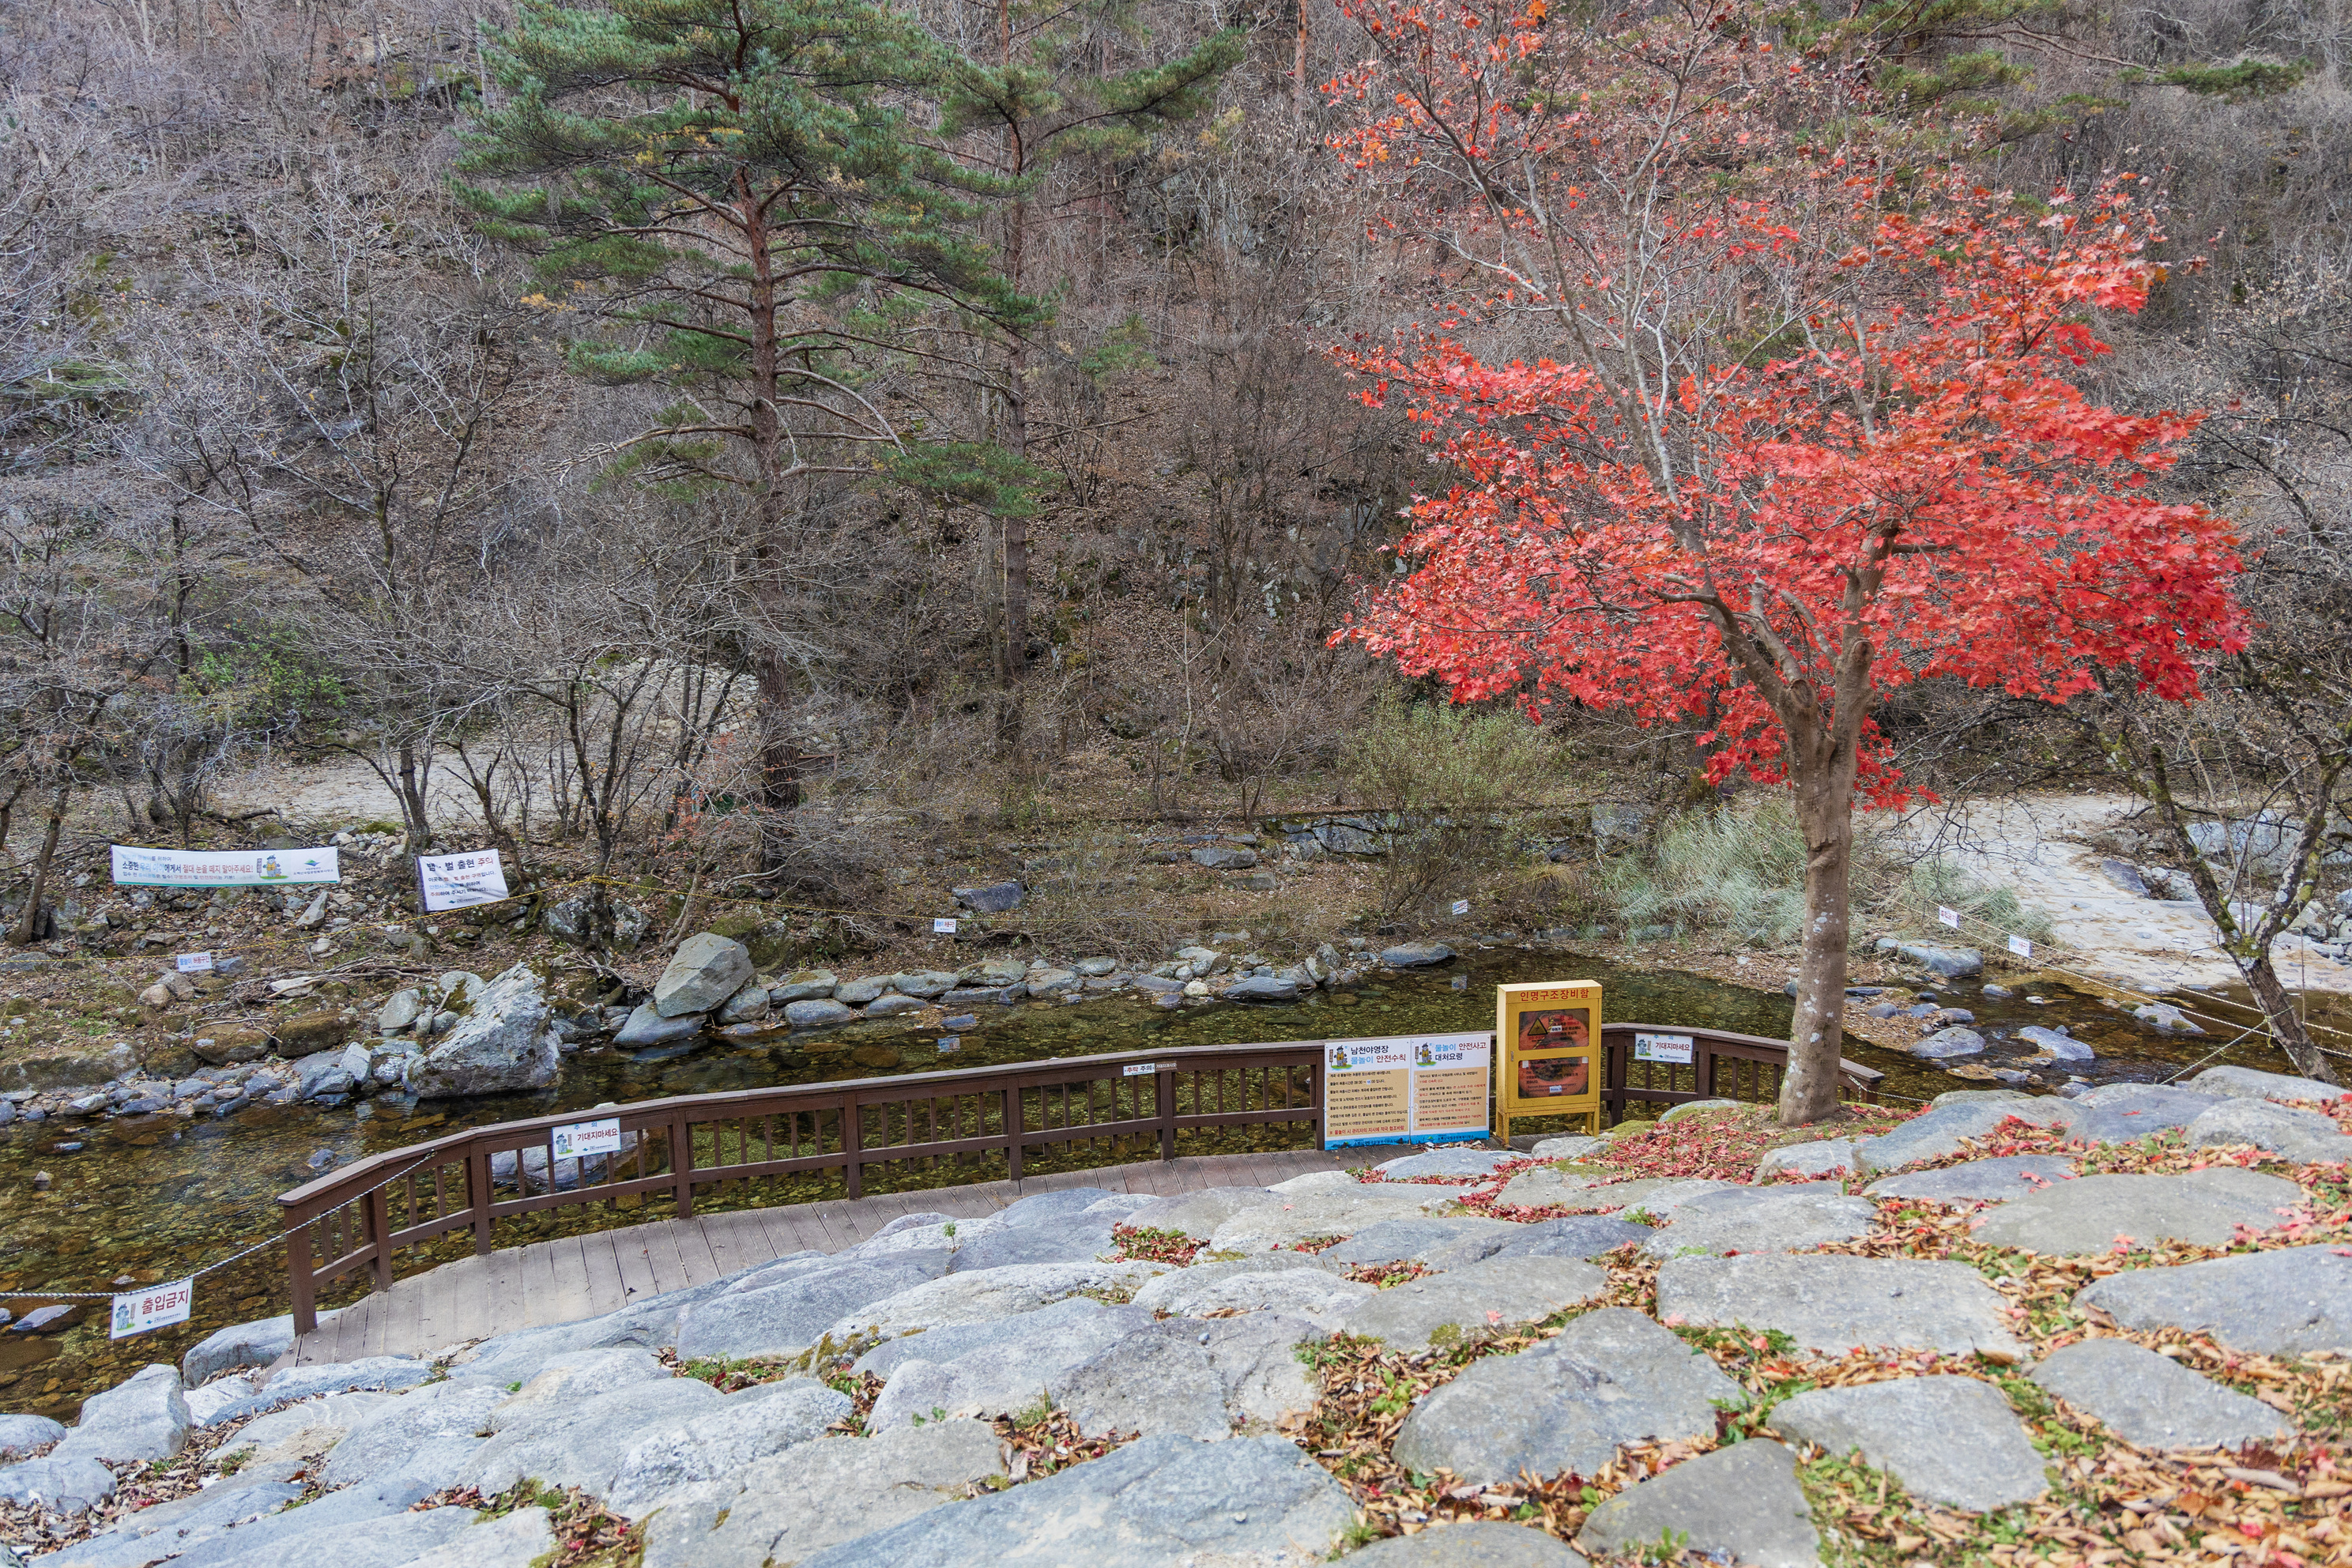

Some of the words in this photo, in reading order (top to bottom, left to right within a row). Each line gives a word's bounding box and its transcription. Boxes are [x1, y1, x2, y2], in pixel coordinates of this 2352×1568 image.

[122, 861, 139, 871] 소중한
[140, 863, 151, 872] 우리
[153, 864, 181, 873] 아이에게서
[183, 865, 194, 873] 절대
[196, 865, 207, 873] 눈을
[427, 863, 435, 872] 뱀
[445, 861, 454, 871] 벌
[458, 859, 475, 869] 출현
[478, 857, 493, 866] 주의
[1521, 989, 1589, 1001] 인명구조장비함
[1351, 1046, 1389, 1054] 남천야영장
[1435, 1043, 1456, 1052] 물놀이
[1656, 1042, 1690, 1050] 기대지마세요
[1351, 1056, 1373, 1065] 물놀이
[1377, 1054, 1406, 1063] 안전수칙
[1414, 1088, 1418, 1097] 2
[1414, 1103, 1418, 1112] 3
[578, 1129, 618, 1141] 기대지마세요
[142, 1288, 189, 1315] 출입금지
